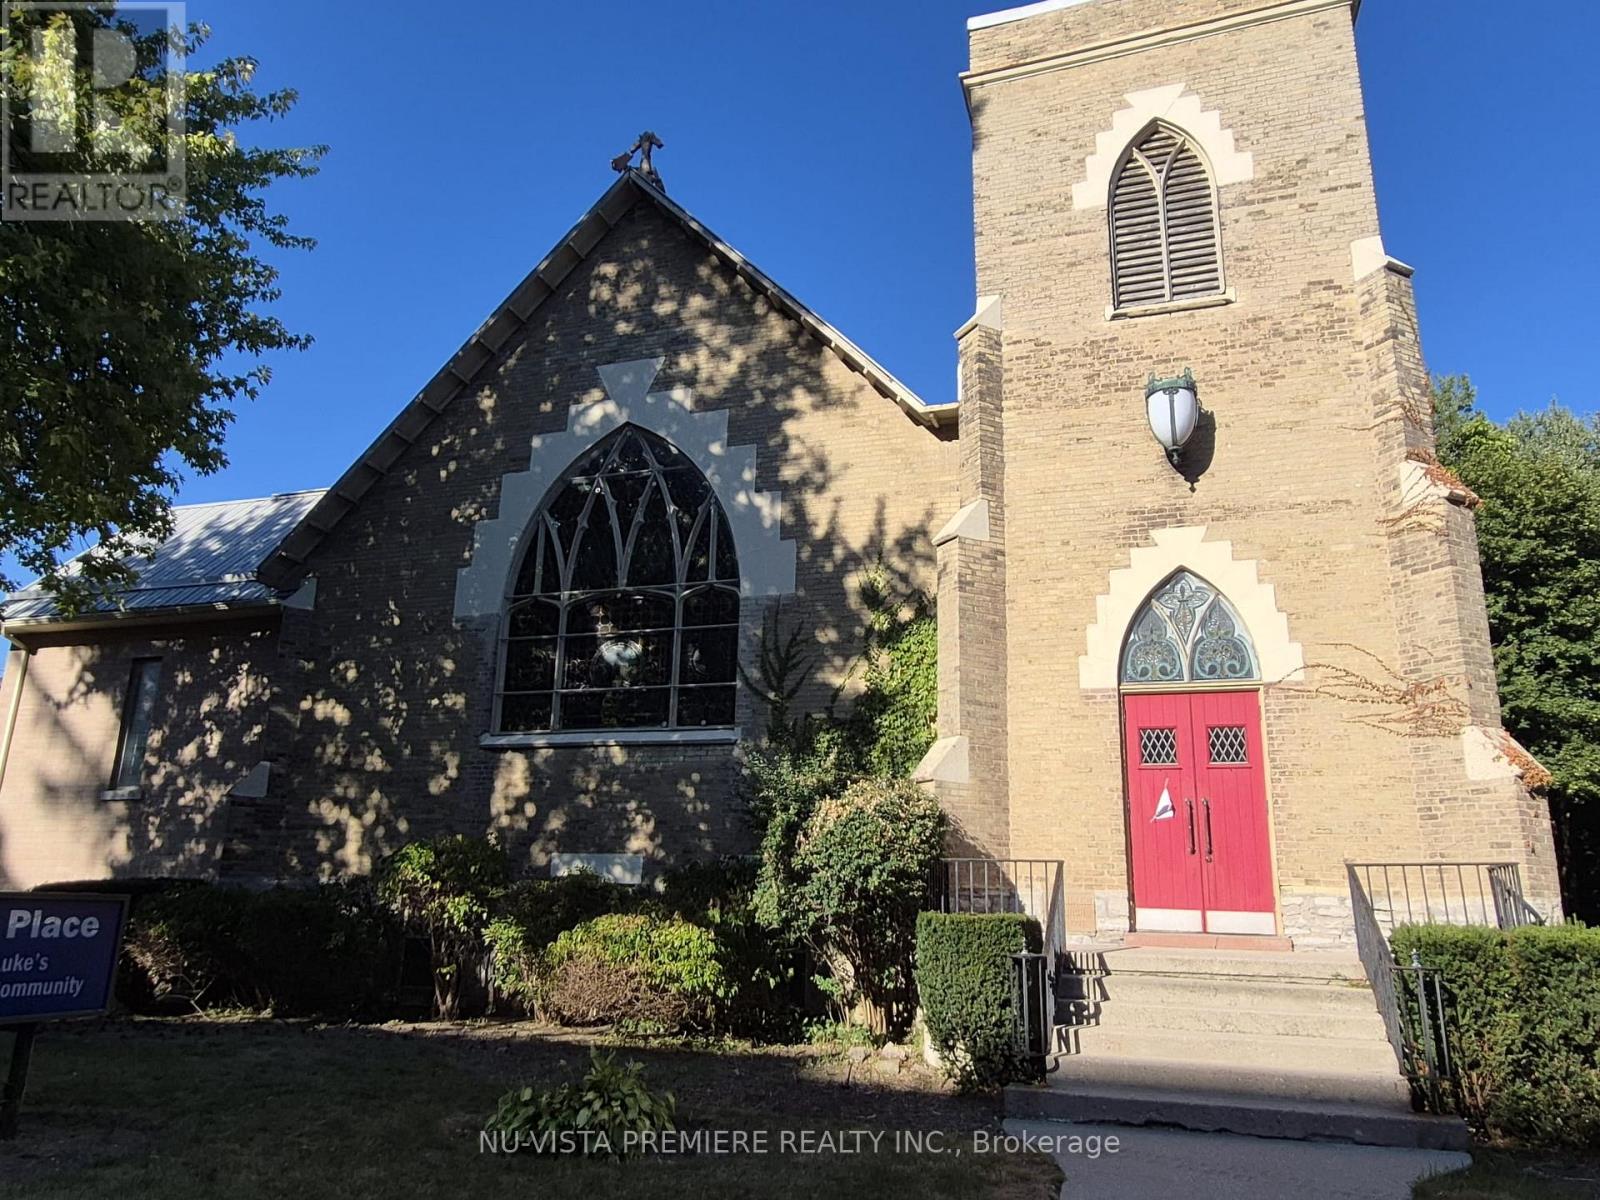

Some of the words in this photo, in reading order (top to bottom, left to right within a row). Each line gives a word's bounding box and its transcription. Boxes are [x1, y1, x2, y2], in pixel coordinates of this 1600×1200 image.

[6, 909, 100, 939] Place
[0, 952, 49, 973] uke's
[0, 975, 84, 998] ommunity
